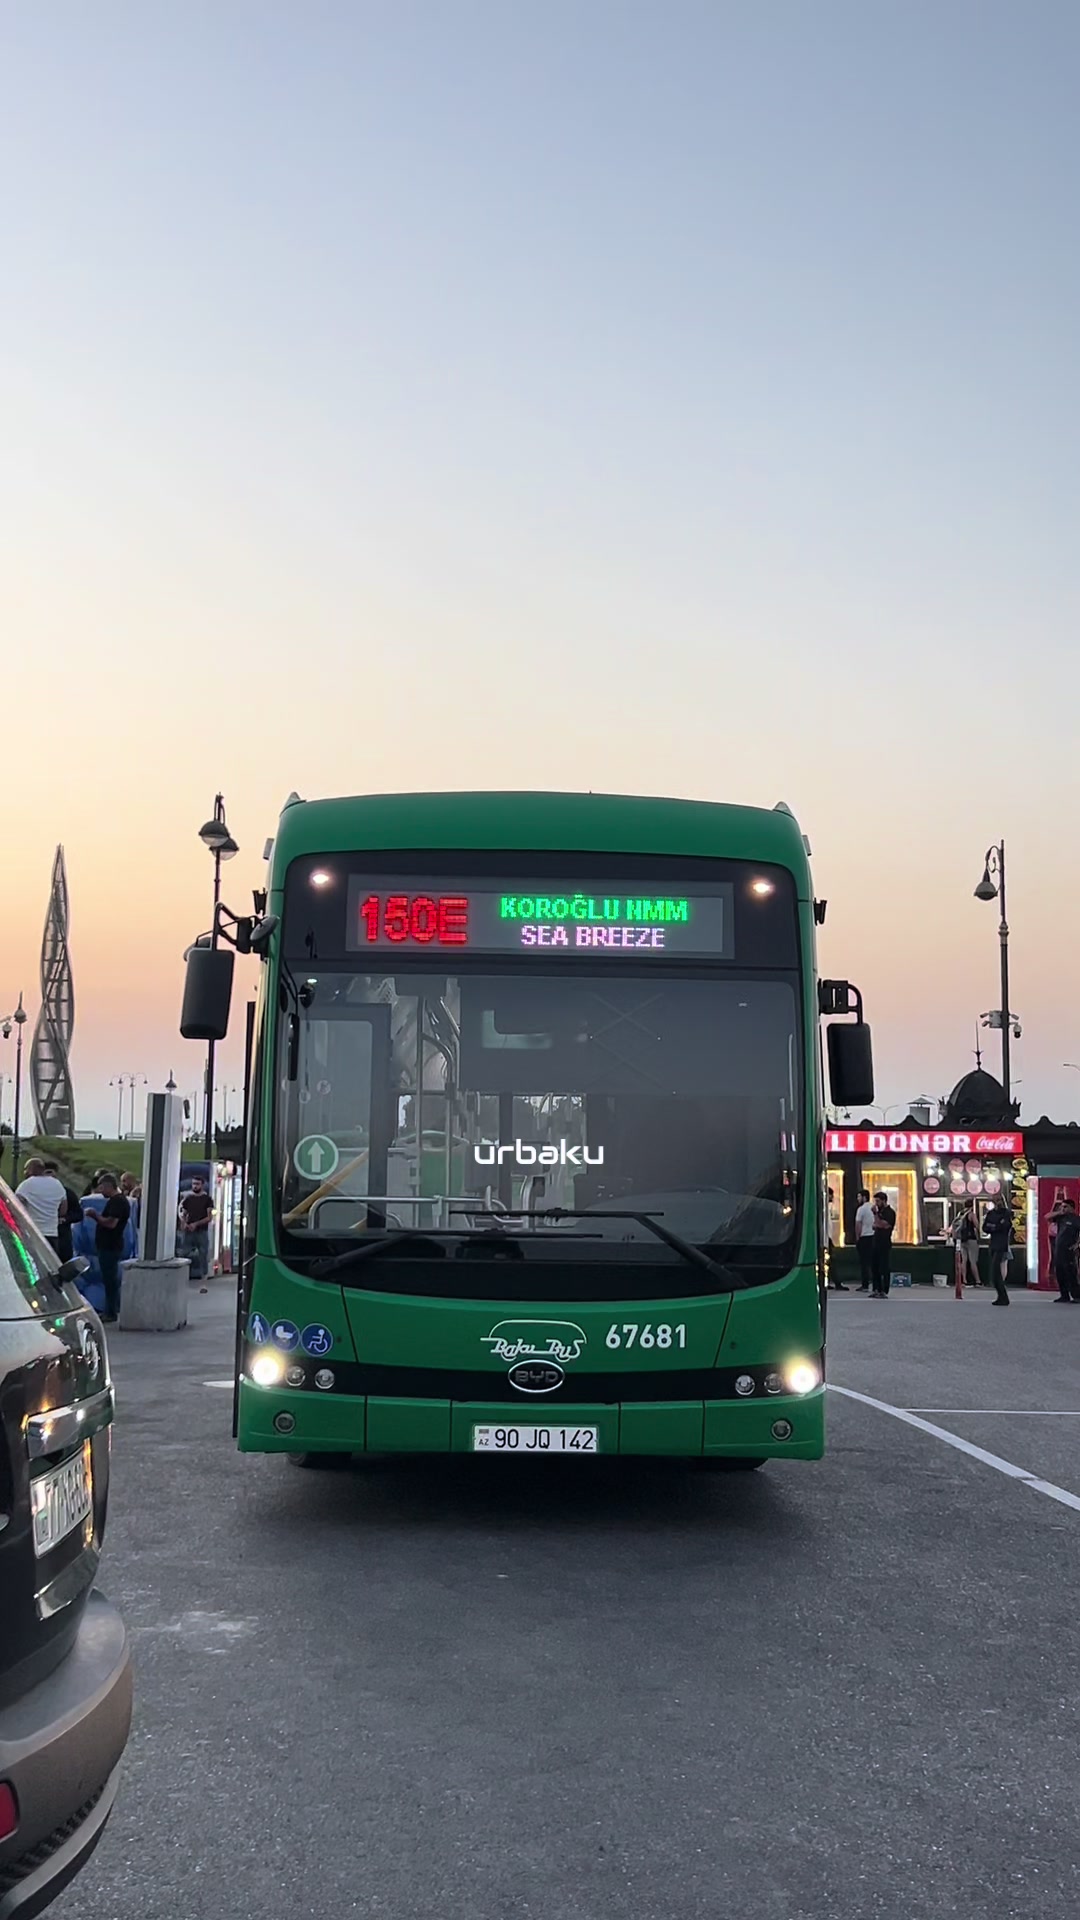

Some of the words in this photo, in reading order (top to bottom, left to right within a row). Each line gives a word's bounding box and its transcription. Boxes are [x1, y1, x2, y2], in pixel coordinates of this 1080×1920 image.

[500, 894, 620, 920] KOROĞLU
[626, 899, 688, 921] NMM
[361, 896, 468, 943] 150E
[521, 925, 568, 946] SEA
[575, 926, 665, 948] BREEZE
[868, 1132, 971, 1152] DÖNƏR
[605, 1323, 686, 1349] 67681
[480, 1337, 536, 1361] Baku
[515, 1370, 559, 1383] BYD
[478, 1438, 490, 1447] AZ
[495, 1429, 519, 1449] 90
[526, 1429, 550, 1449] JQ
[559, 1429, 594, 1450] 142
